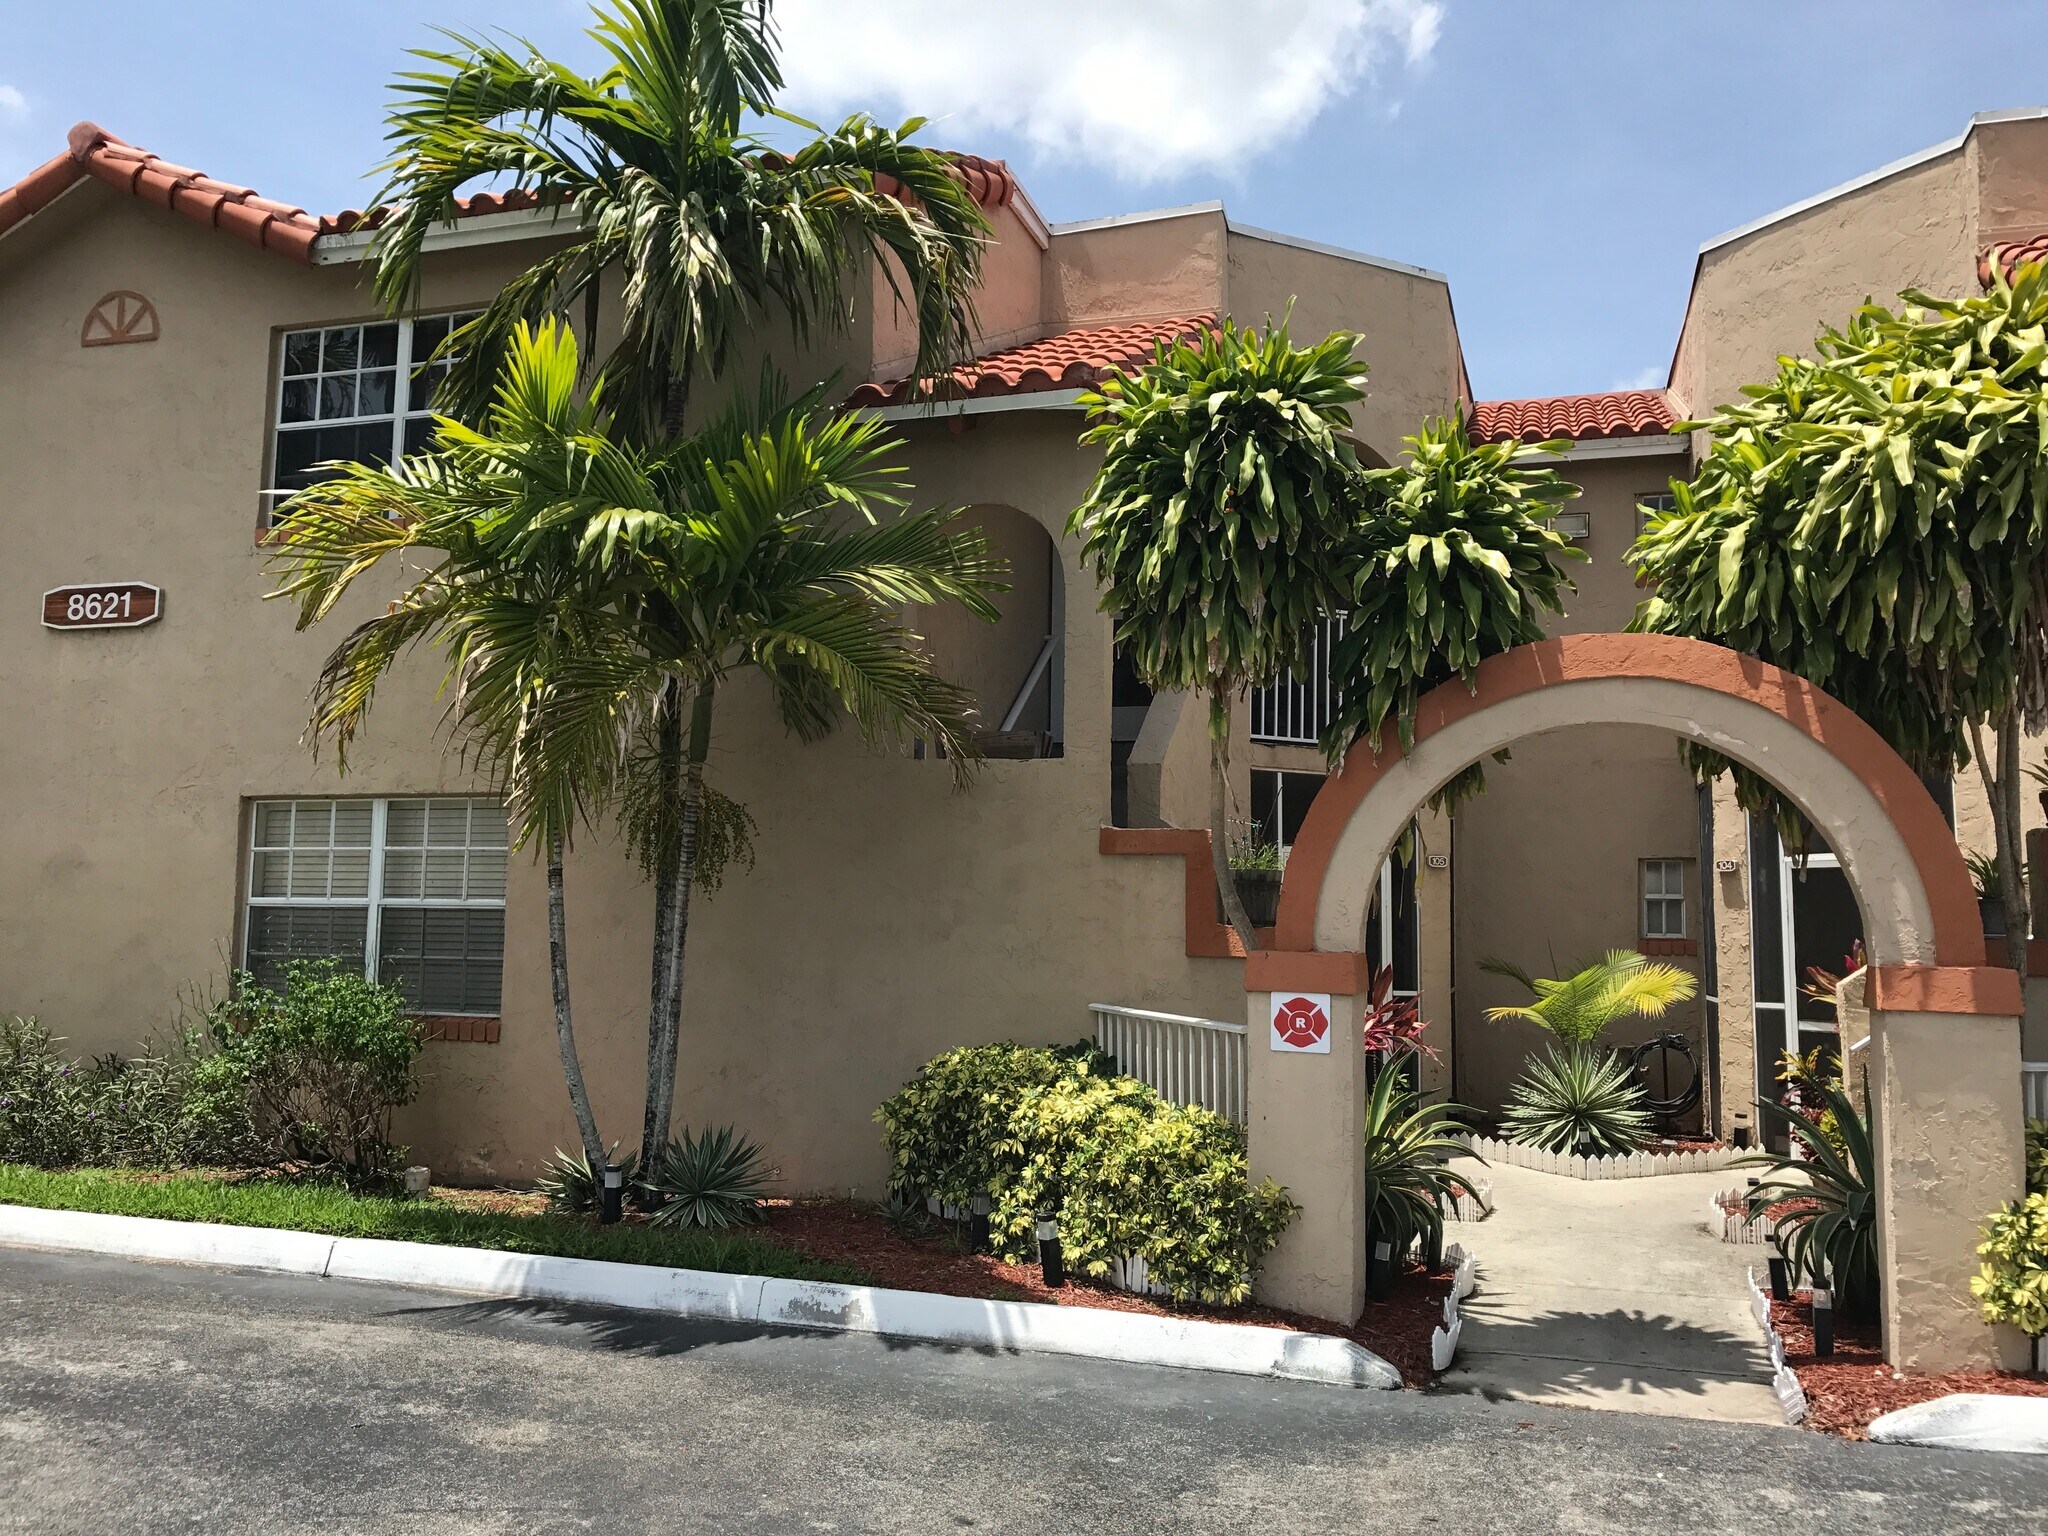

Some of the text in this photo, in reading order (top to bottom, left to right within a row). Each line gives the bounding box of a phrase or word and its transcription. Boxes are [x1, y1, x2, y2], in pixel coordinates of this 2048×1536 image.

[67, 591, 131, 620] 8621
[1718, 861, 1733, 870] 104
[1295, 1017, 1306, 1028] R
